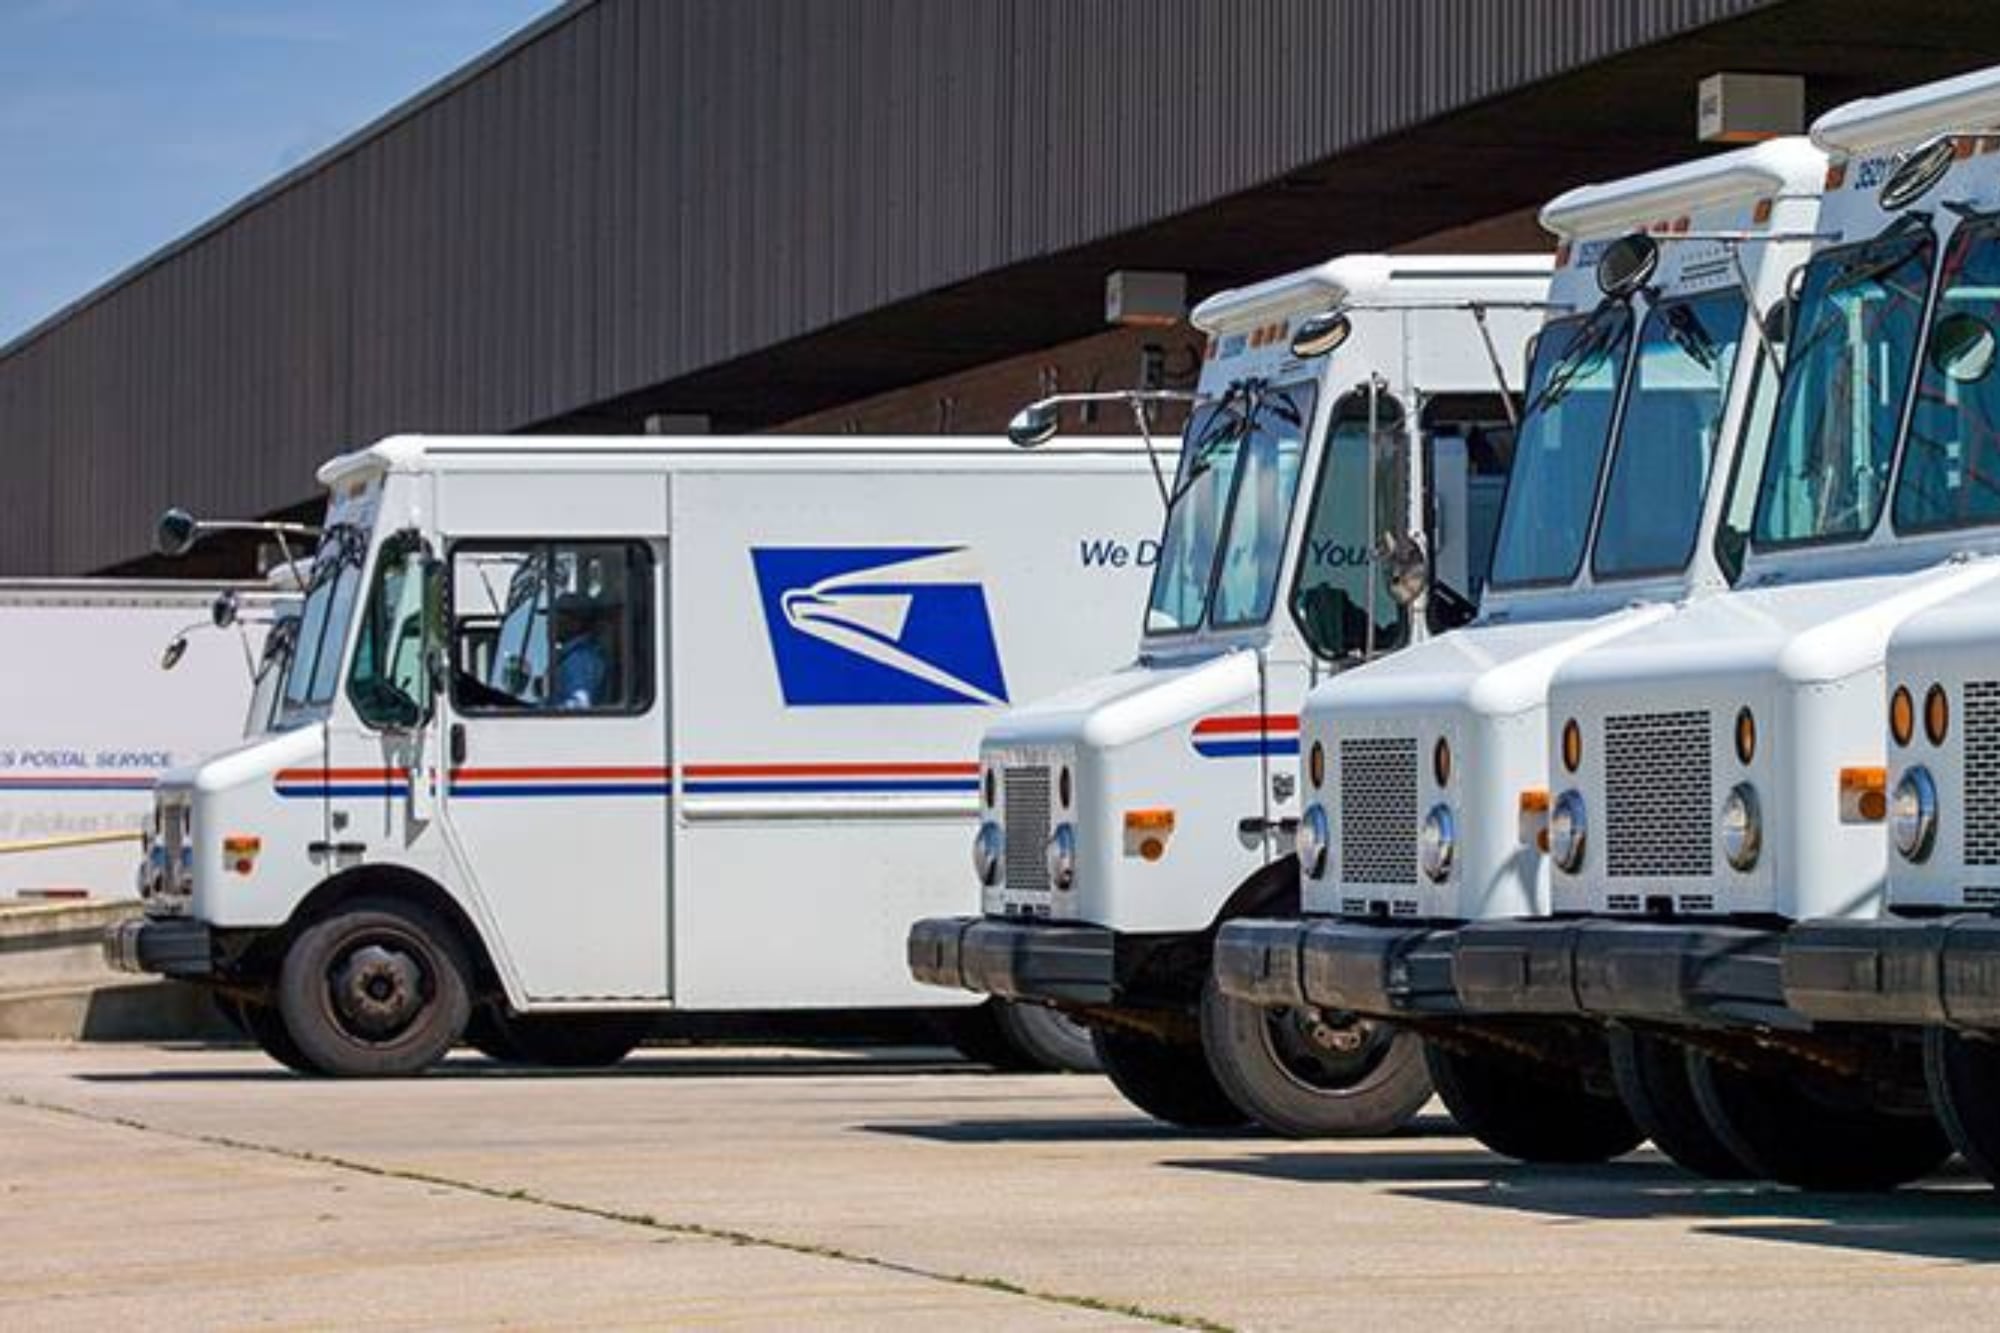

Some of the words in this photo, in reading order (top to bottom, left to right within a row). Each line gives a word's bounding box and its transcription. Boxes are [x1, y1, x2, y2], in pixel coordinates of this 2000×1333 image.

[1080, 539, 1129, 568] We
[1137, 539, 1161, 566] D
[1310, 539, 1369, 568] You.
[20, 750, 87, 768] POSTAL
[95, 750, 171, 768] SERVICE
